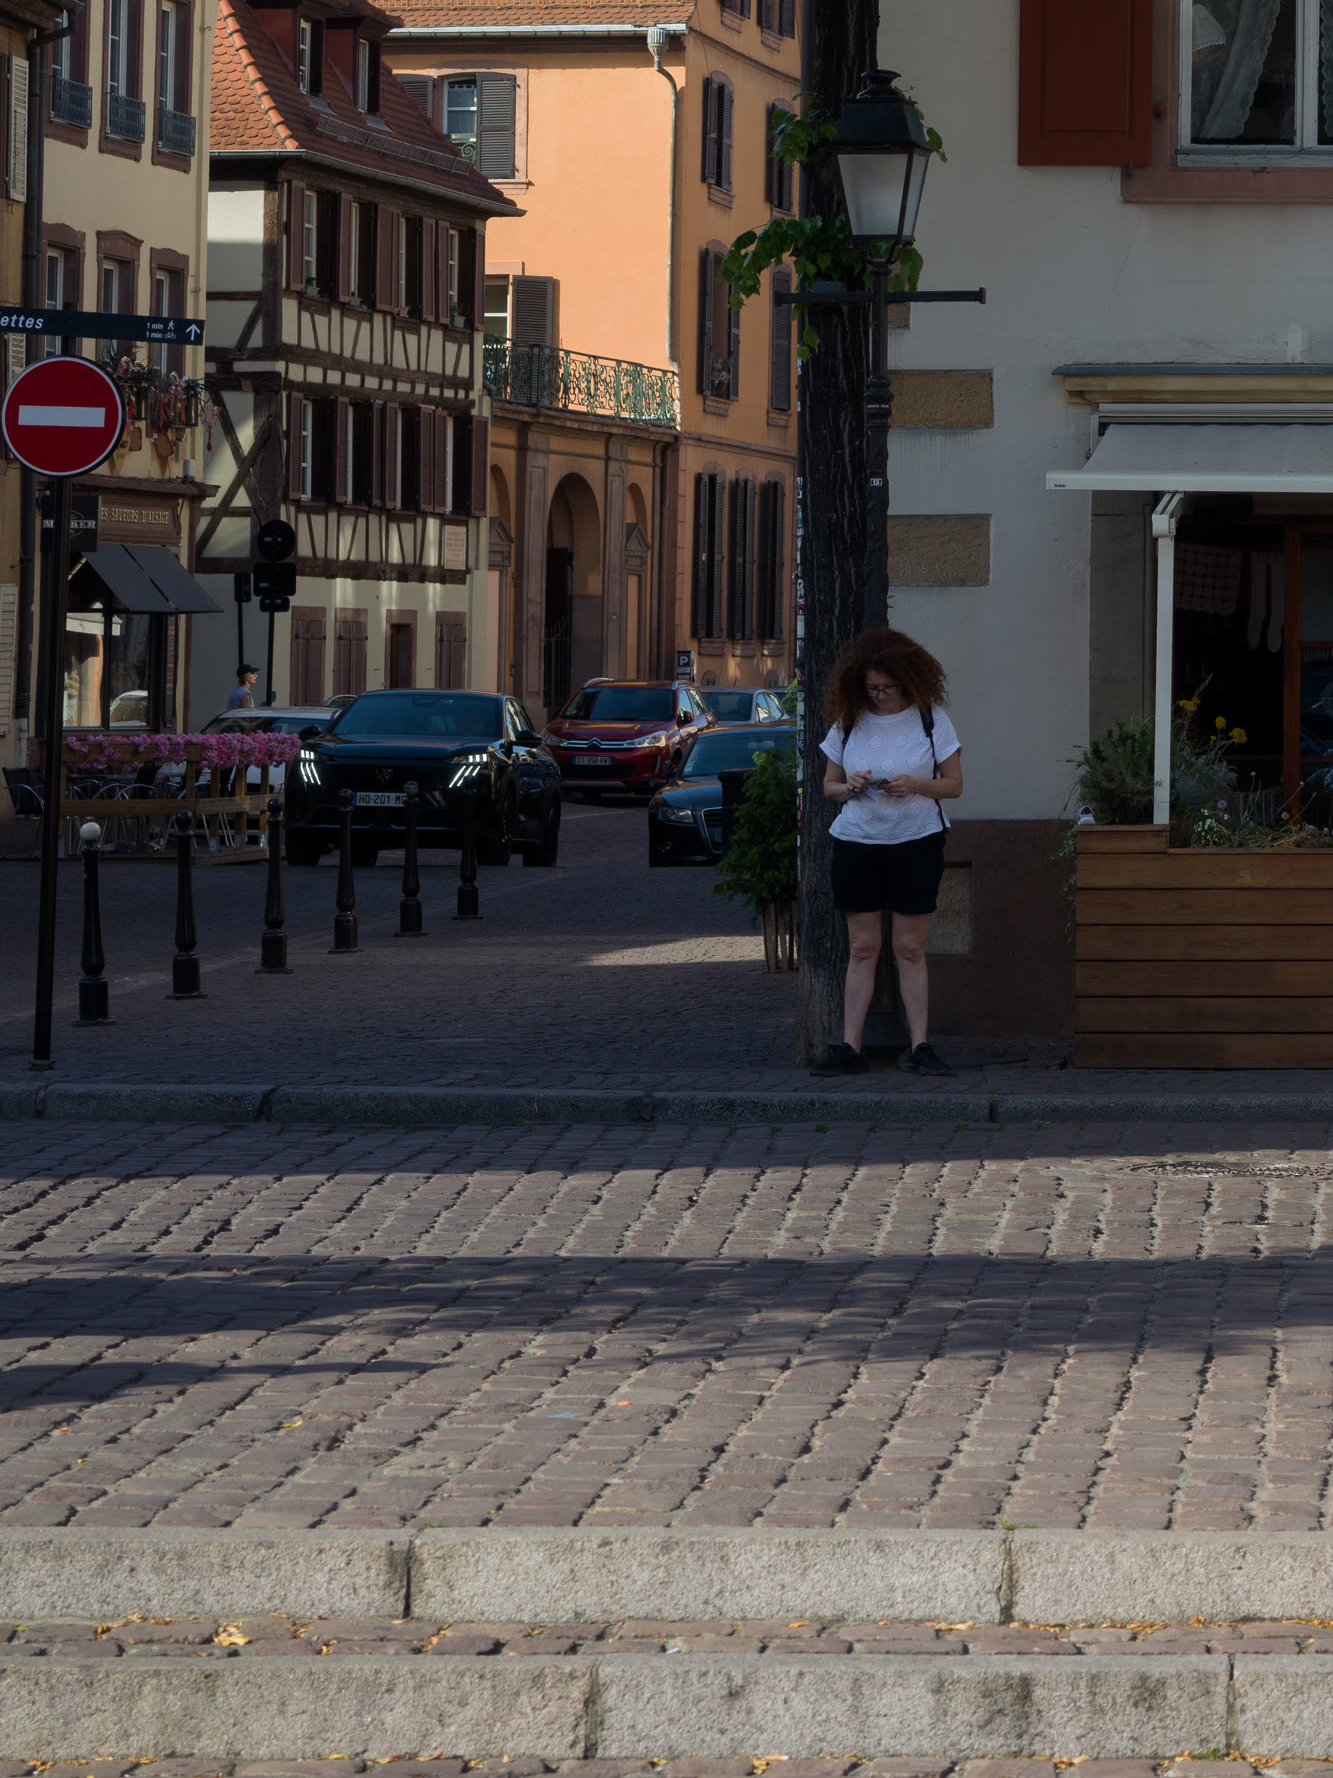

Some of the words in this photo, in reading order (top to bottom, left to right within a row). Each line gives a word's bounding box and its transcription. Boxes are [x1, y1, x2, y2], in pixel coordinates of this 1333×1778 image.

[0, 314, 45, 330] ettes
[151, 322, 164, 330] min
[150, 331, 163, 339] min
[141, 510, 170, 525] D'ALSACE
[679, 655, 690, 666] P
